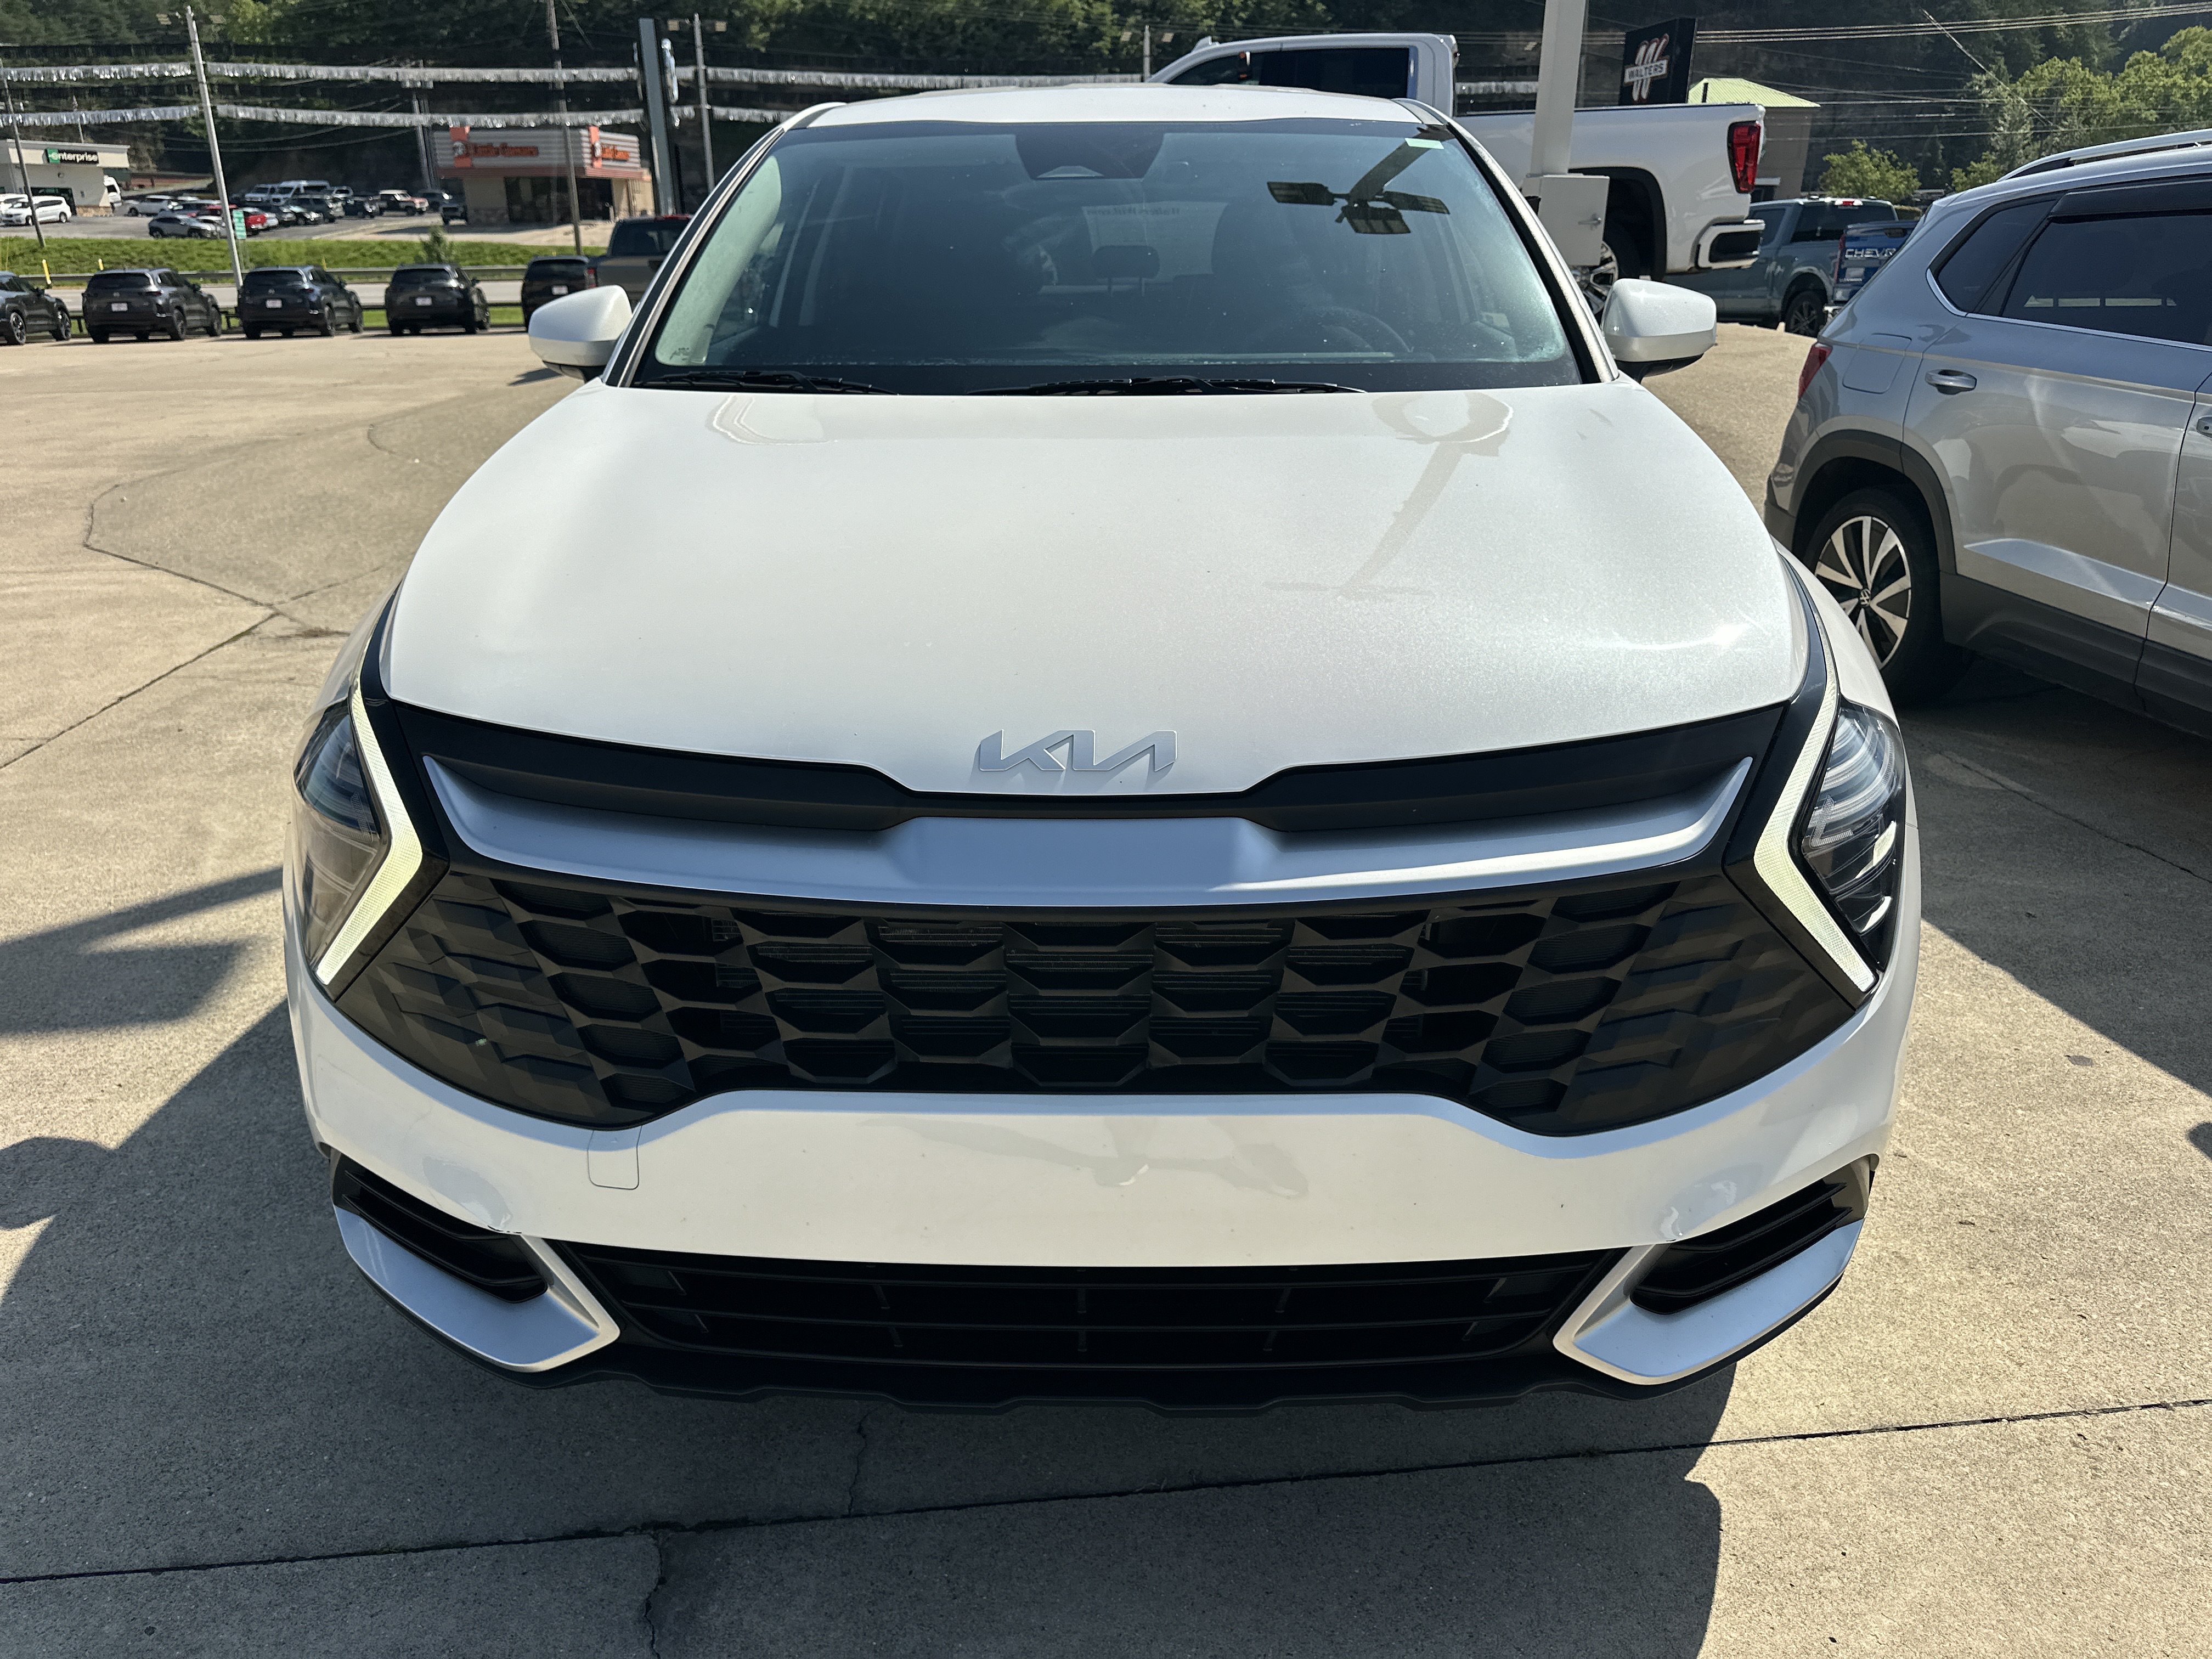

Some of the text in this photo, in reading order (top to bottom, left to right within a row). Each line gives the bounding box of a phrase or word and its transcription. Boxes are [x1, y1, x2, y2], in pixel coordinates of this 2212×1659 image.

[1628, 63, 1664, 80] WALTERS
[48, 152, 98, 163] enterprise
[980, 729, 1177, 772] KIA
